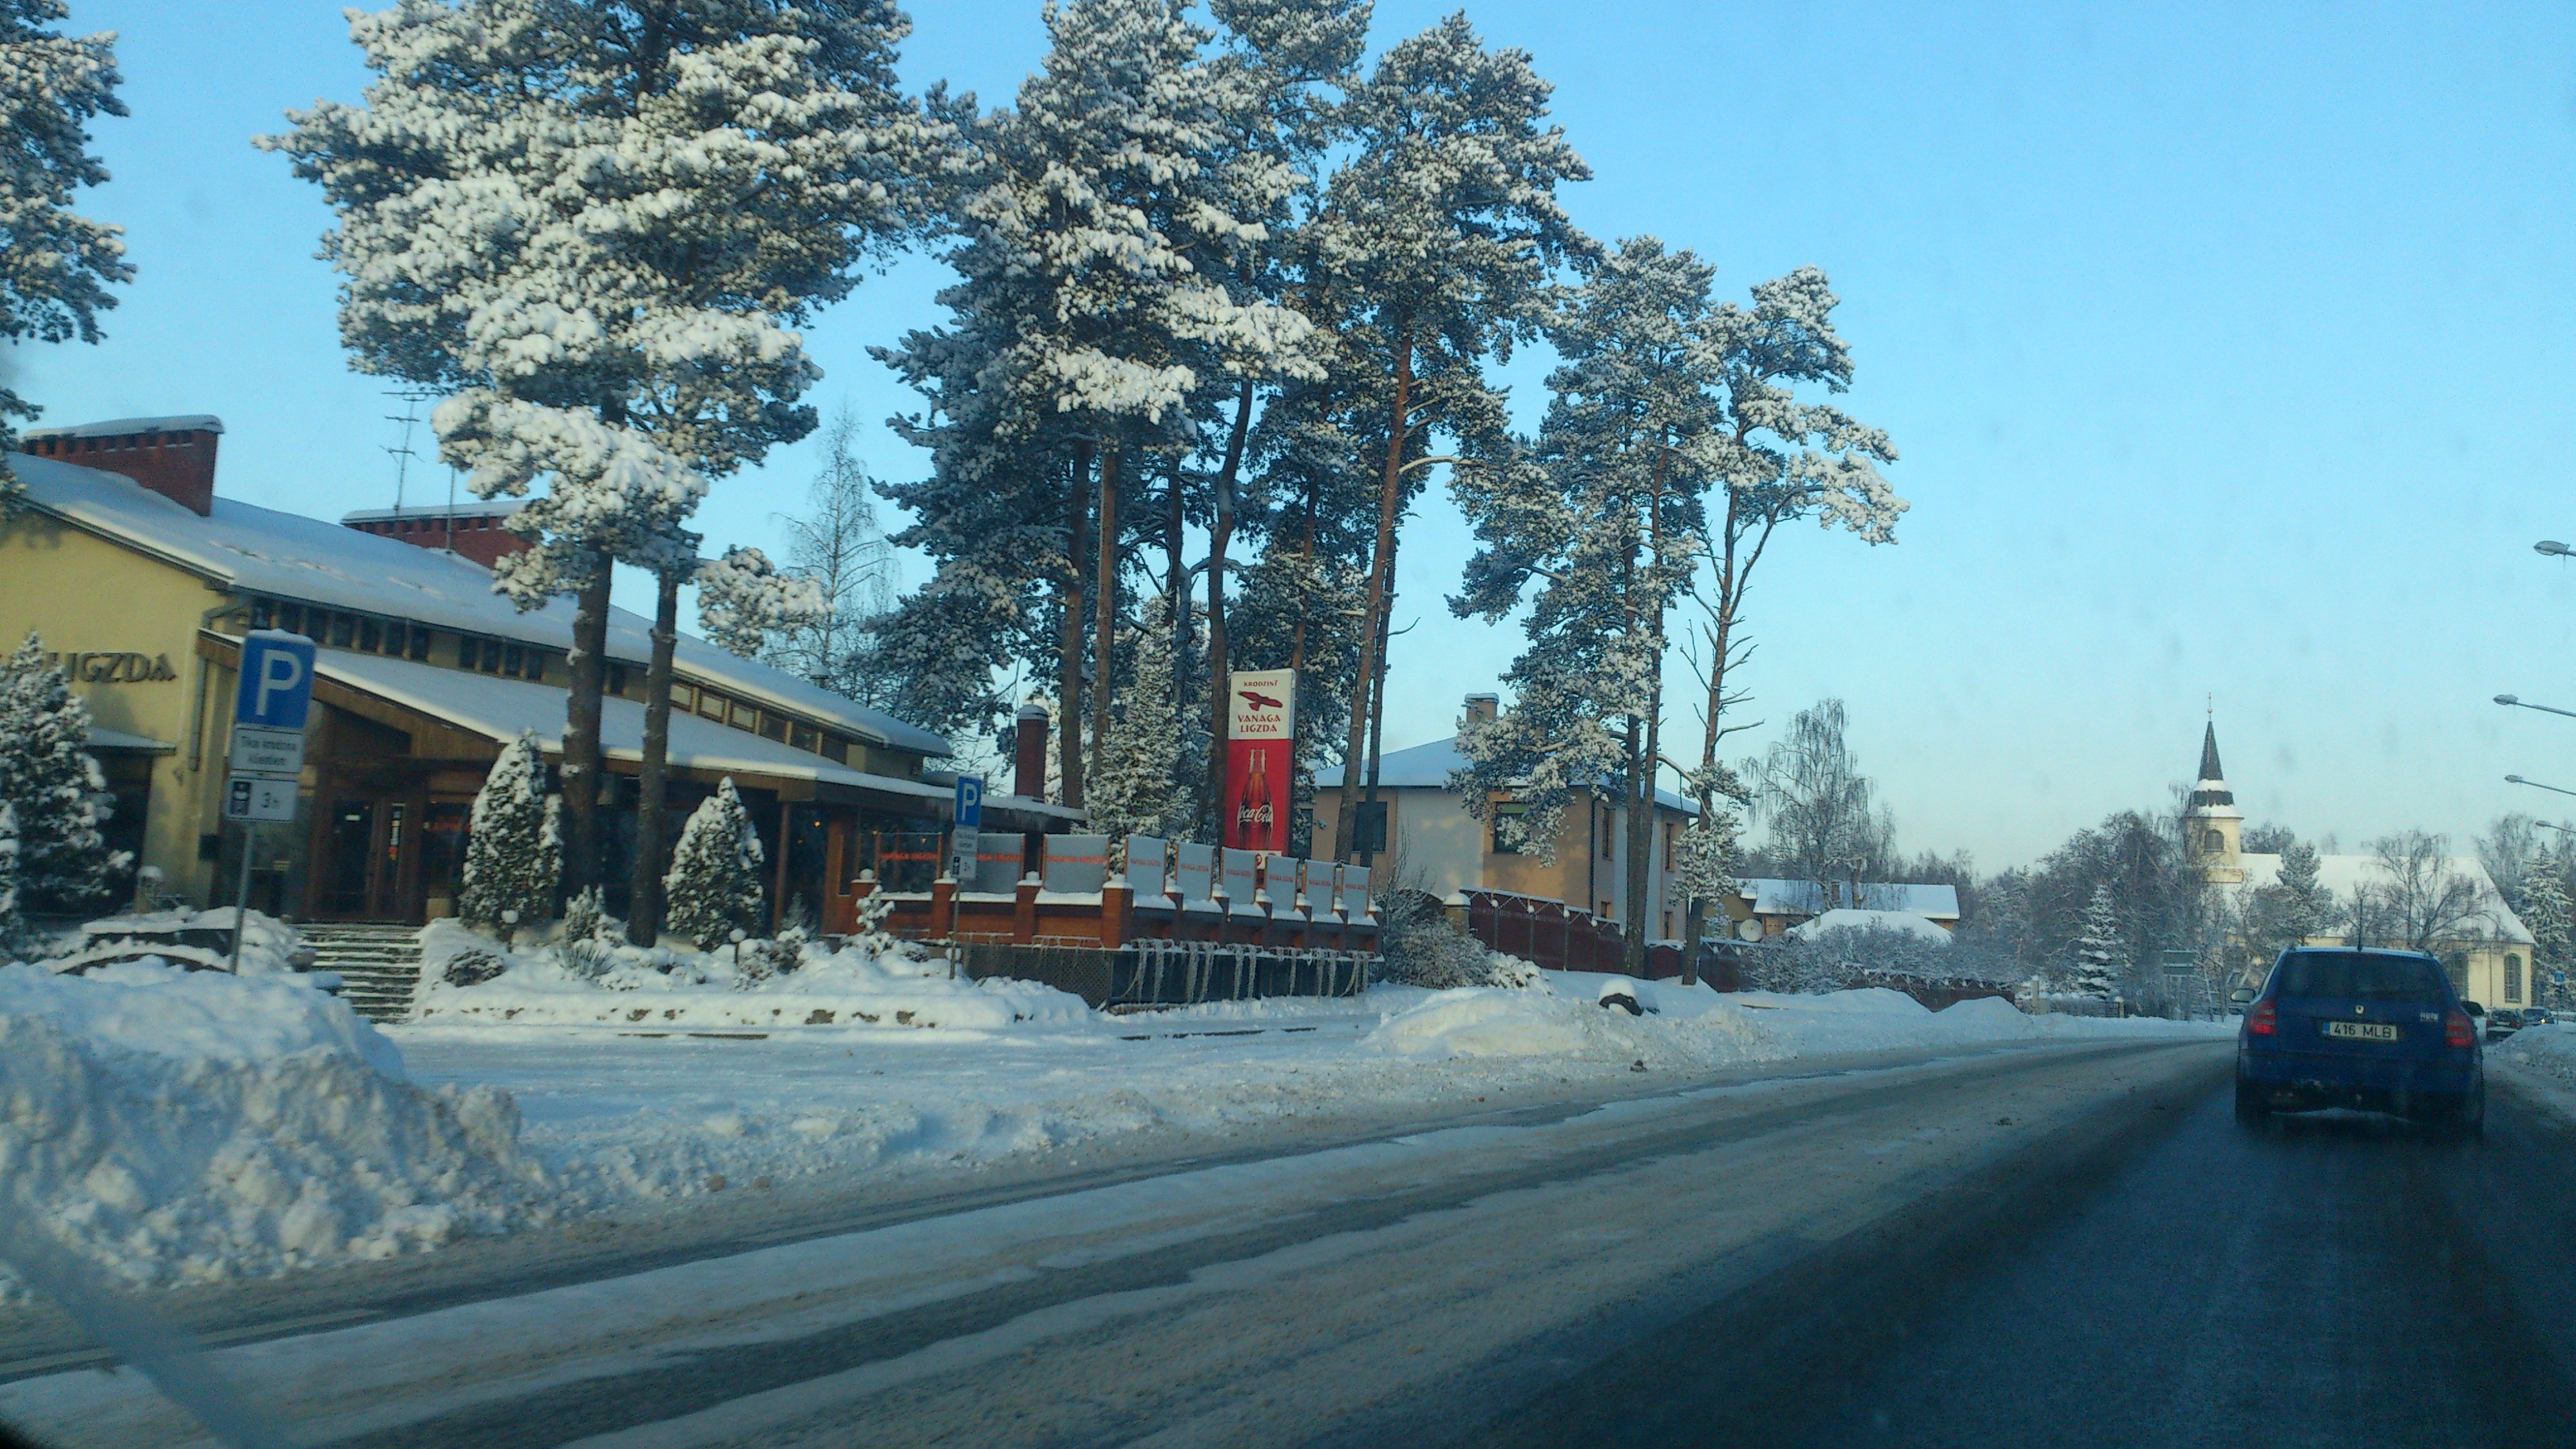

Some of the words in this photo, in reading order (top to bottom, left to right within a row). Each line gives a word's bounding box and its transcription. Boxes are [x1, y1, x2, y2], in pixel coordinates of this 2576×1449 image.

[256, 649, 302, 716] P
[1240, 724, 1277, 732] LIGZDA
[962, 782, 978, 820] P
[2334, 1024, 2356, 1035] 416
